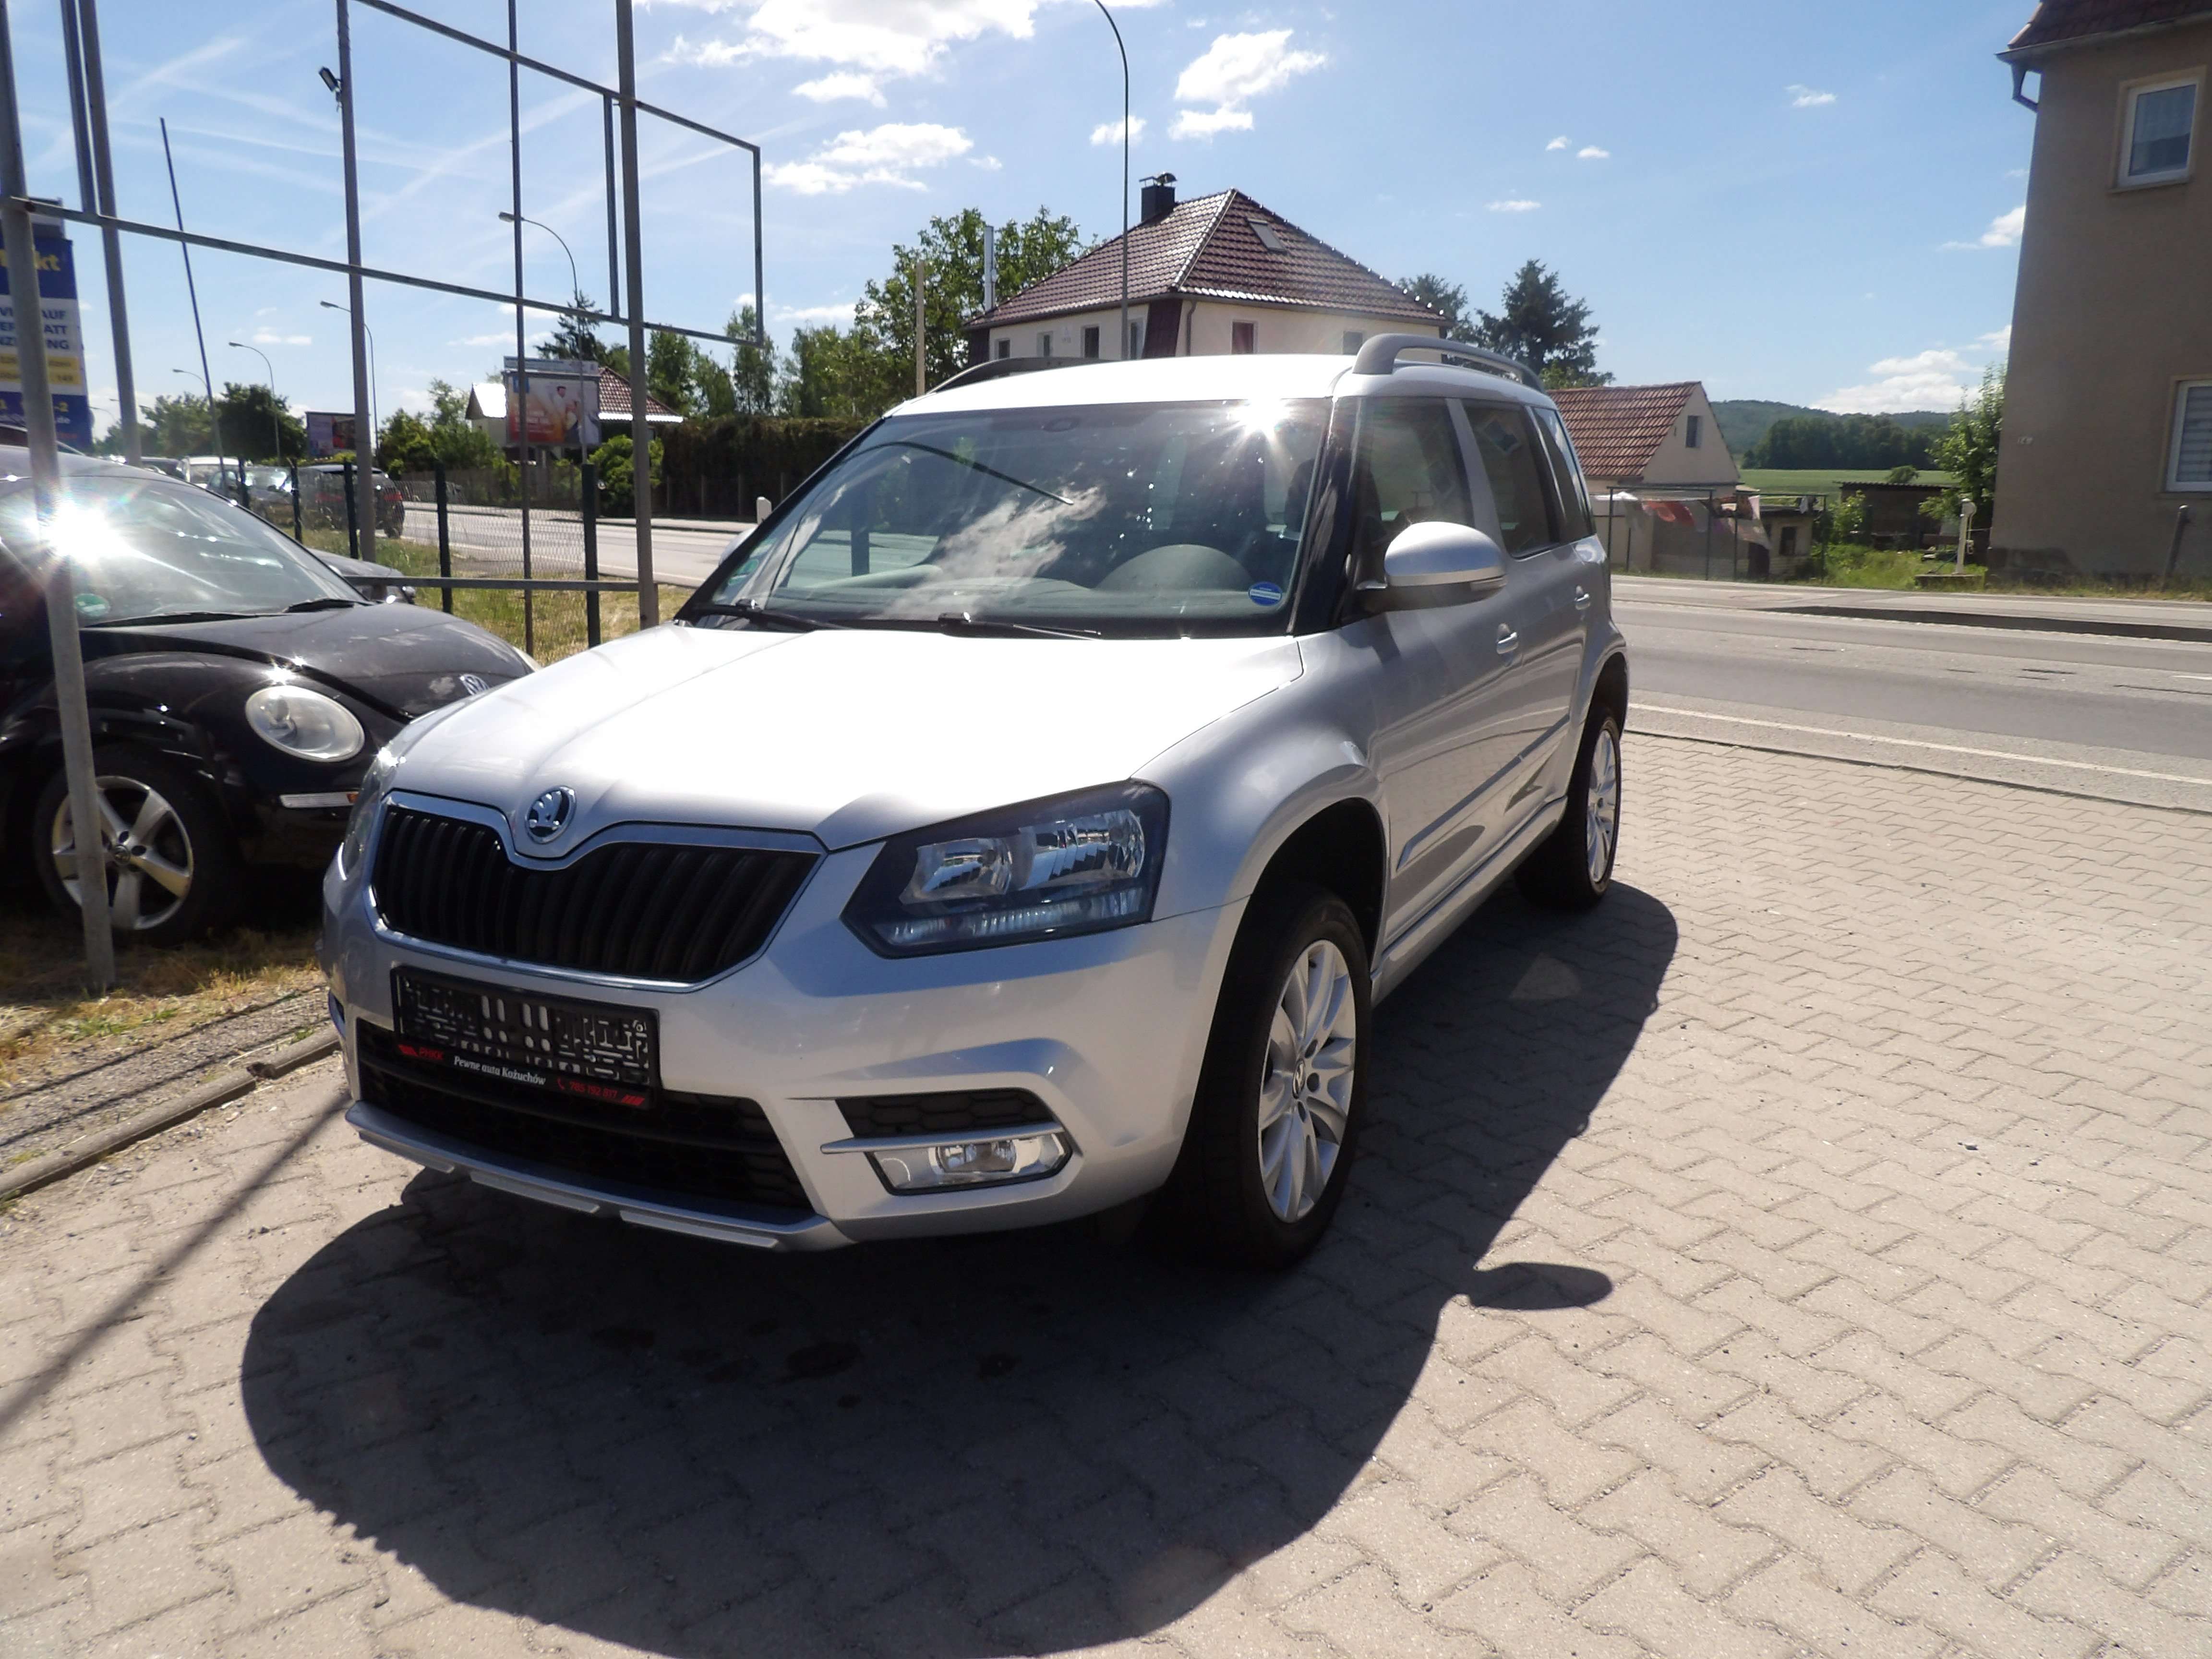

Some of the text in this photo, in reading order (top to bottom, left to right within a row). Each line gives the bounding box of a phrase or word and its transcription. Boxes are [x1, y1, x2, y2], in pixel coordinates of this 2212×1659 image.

[454, 1056, 546, 1085] Pewne auta Kożuchów
